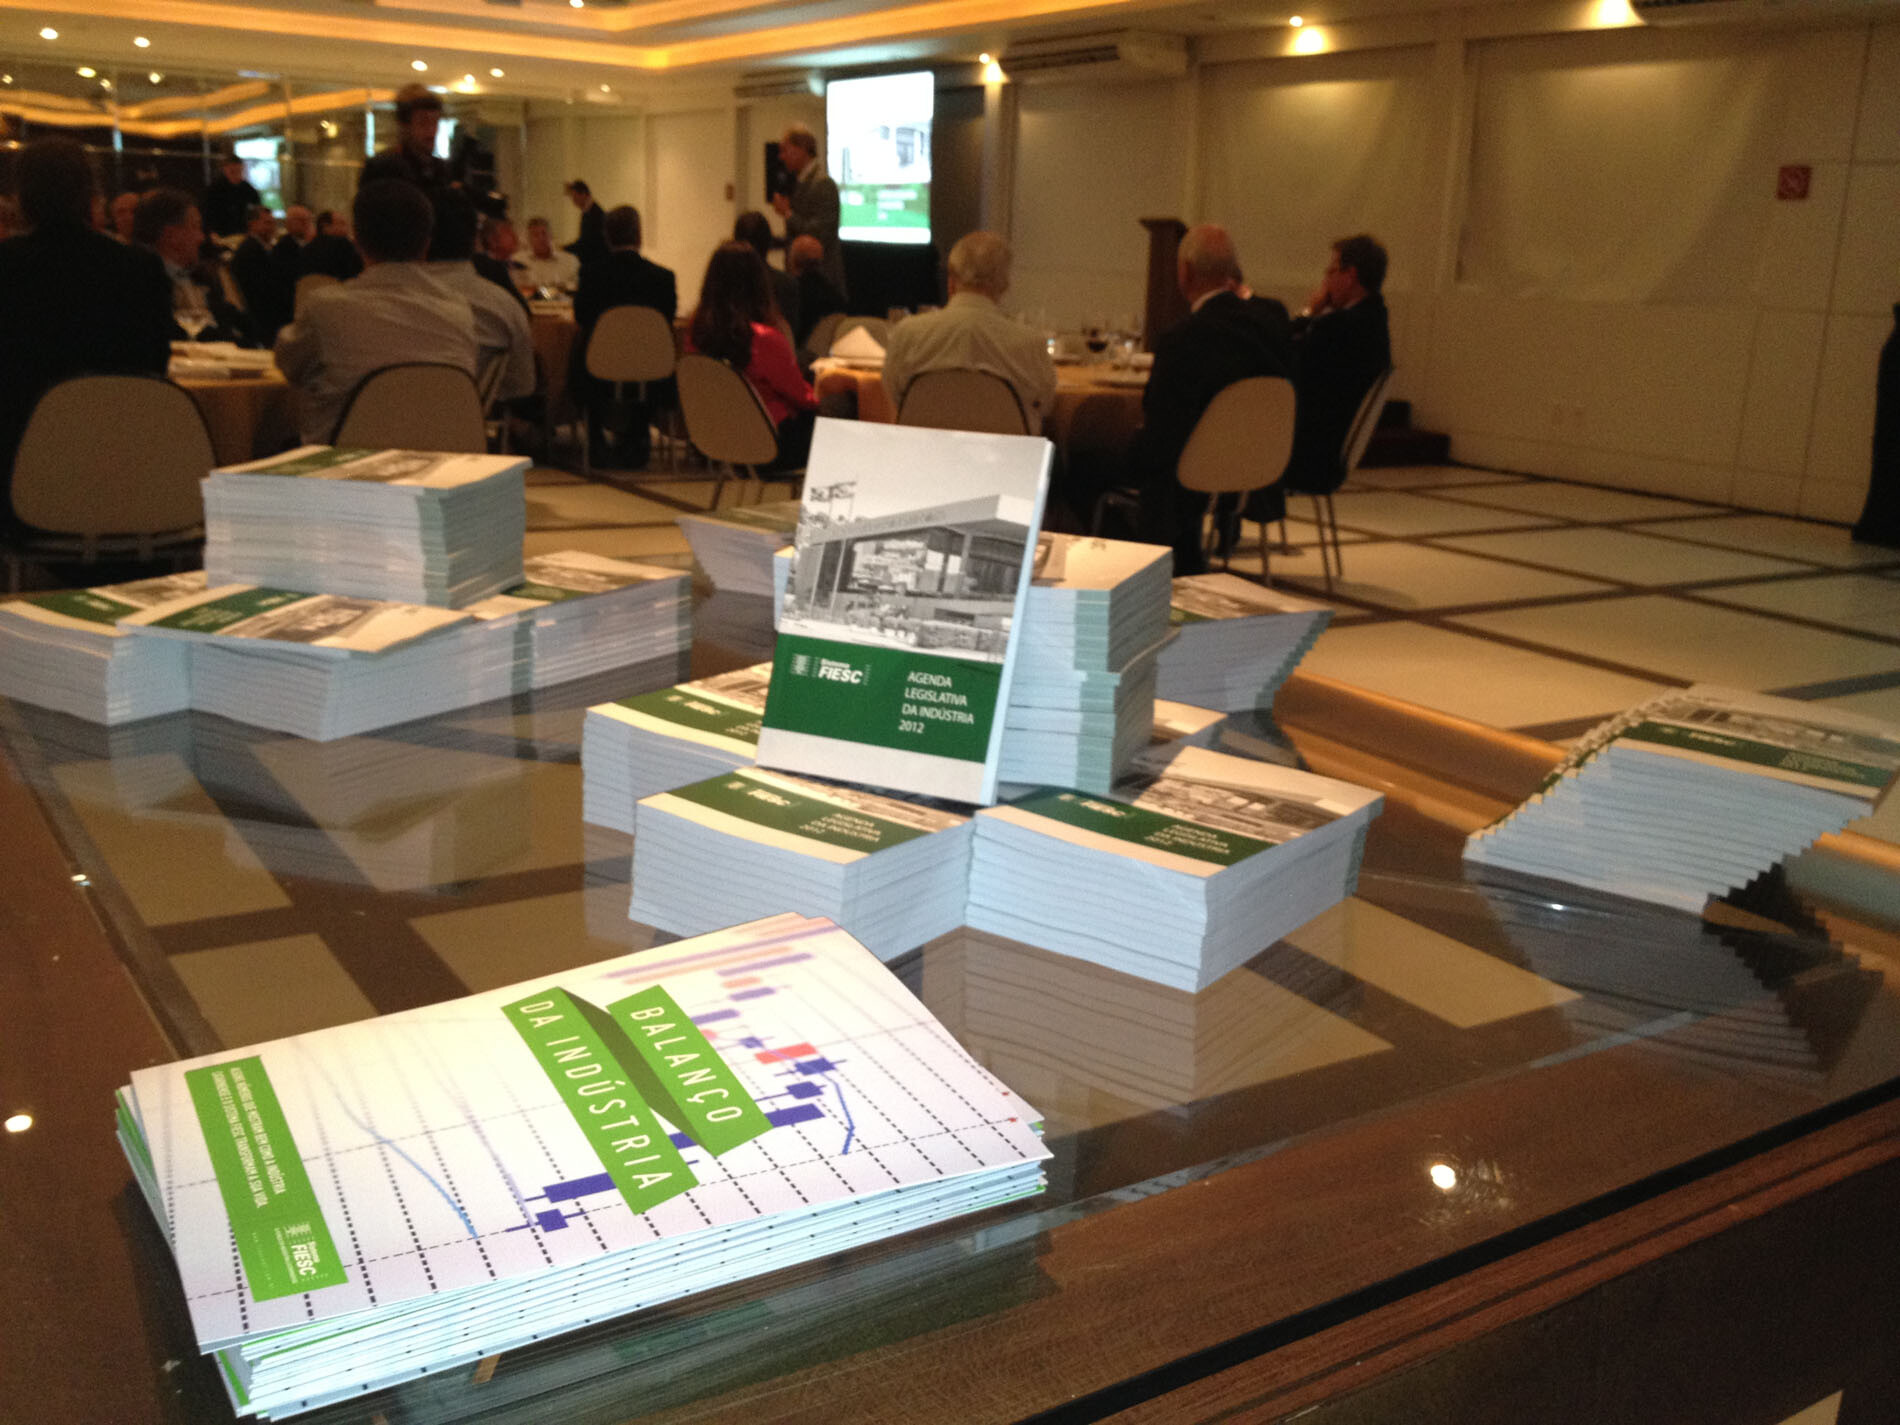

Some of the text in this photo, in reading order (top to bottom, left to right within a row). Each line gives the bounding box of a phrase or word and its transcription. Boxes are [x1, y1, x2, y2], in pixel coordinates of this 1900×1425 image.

[818, 666, 863, 684] FIESC
[907, 671, 952, 688] AGENDA
[904, 687, 968, 706] LEGISLATIVA
[902, 703, 975, 725] DA INDÚSTRIA
[898, 719, 925, 734] 2012
[631, 1006, 743, 1123] BALANÇO
[520, 1001, 673, 1190] DA INDÚSTRIA
[292, 1245, 317, 1276] FIESC
